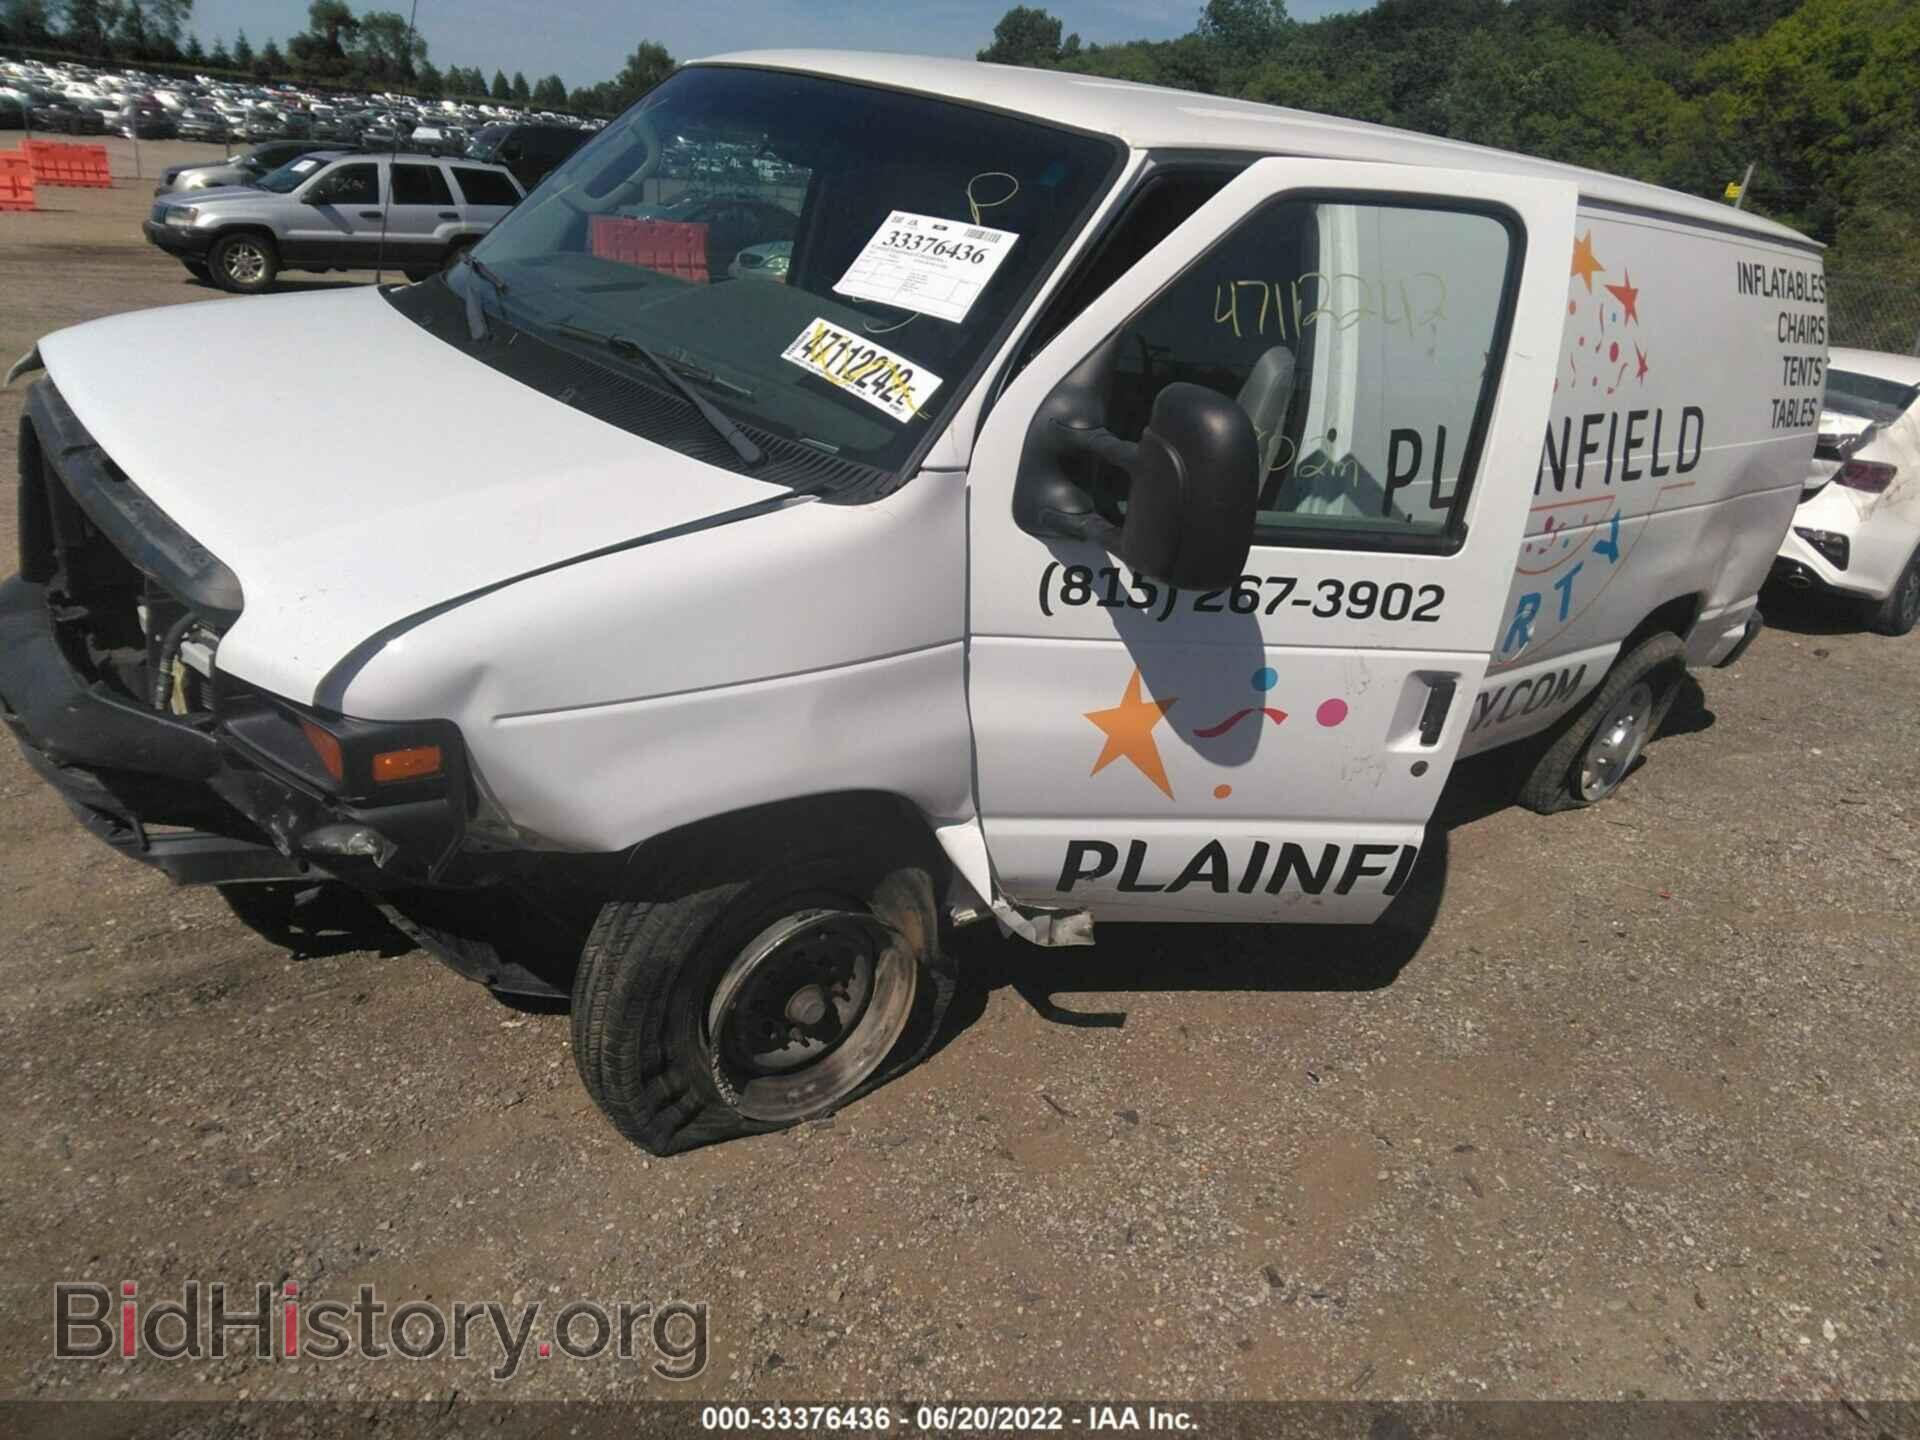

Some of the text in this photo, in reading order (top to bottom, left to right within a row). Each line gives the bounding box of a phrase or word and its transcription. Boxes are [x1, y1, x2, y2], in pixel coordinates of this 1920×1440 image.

[882, 230, 989, 264] 33376436
[1737, 261, 1825, 304] INFLATABLES
[1777, 311, 1825, 345] CHAIRS
[1783, 356, 1822, 386] TENTS
[1771, 398, 1817, 429] TABLES
[1039, 561, 1444, 622] (815) 267-3902
